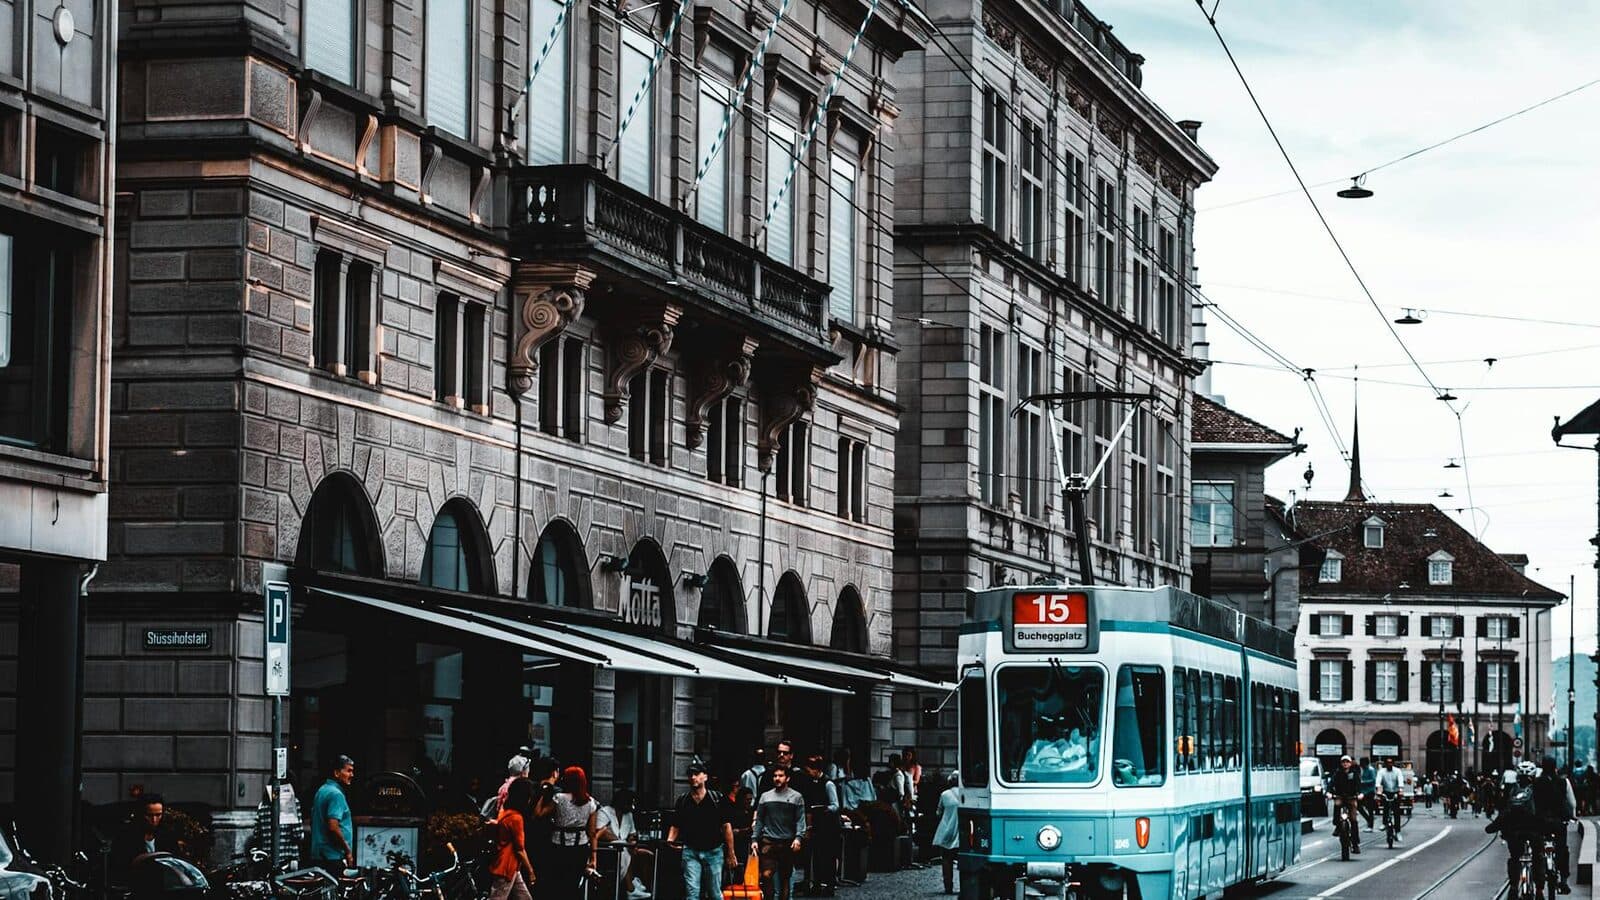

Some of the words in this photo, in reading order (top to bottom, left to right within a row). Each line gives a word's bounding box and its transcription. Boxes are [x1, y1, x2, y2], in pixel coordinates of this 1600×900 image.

[617, 571, 662, 627] Motta
[1032, 594, 1070, 623] 15
[272, 598, 283, 637] P
[147, 631, 207, 645] Stüssihofstatt
[1017, 631, 1083, 642] Bucheggplatz
